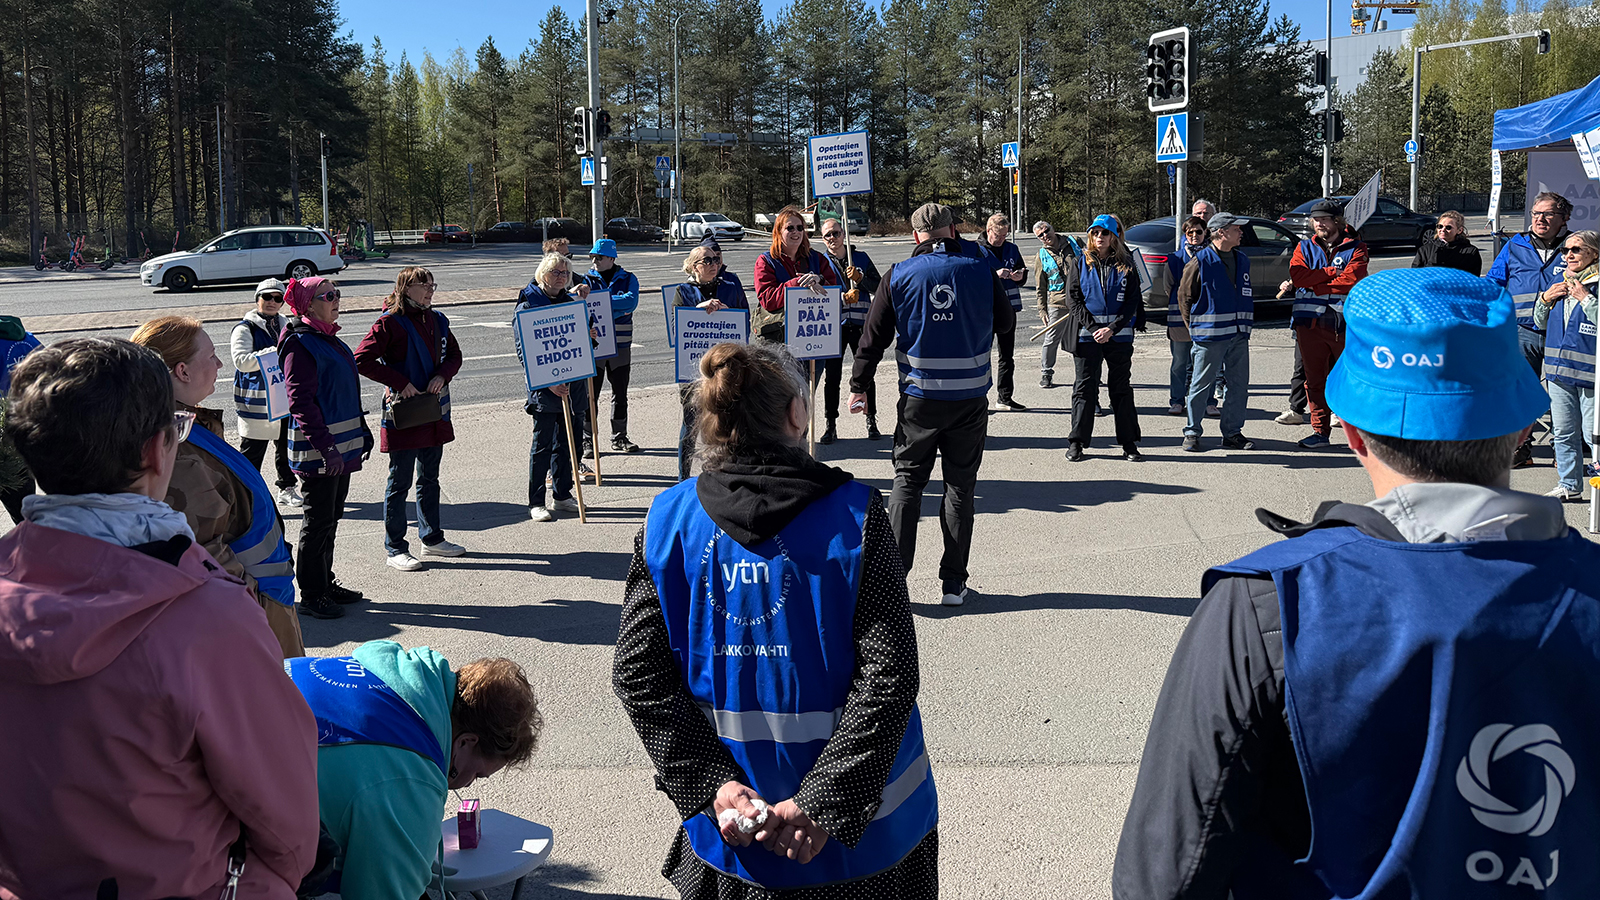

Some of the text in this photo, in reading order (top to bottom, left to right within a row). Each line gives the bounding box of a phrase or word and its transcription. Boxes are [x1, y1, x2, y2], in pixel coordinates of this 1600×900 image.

[818, 143, 859, 153] Opettajien
[816, 151, 863, 161] arvostuksen
[817, 159, 863, 171] pitää näkyä
[823, 168, 859, 179] palkassa!
[797, 296, 821, 305] Palkka
[532, 313, 576, 326] ANSAITSEMME
[797, 305, 830, 323] PÄÄ-
[932, 312, 954, 321] OAJ
[533, 322, 576, 340] REILUT
[686, 320, 737, 331] Opettajien
[795, 323, 833, 338] ASIA!
[683, 331, 741, 340] arvostuksen
[542, 334, 572, 351] TYÖ-
[683, 340, 710, 350] pitää
[536, 347, 583, 366] EHDOT!
[1401, 352, 1444, 367] OAJ
[722, 558, 770, 593] ytn
[733, 573, 792, 626] TJÄNSTEMÄNNEN
[713, 644, 788, 657] LAKKOVAHTI
[1465, 849, 1560, 891] OAJ
